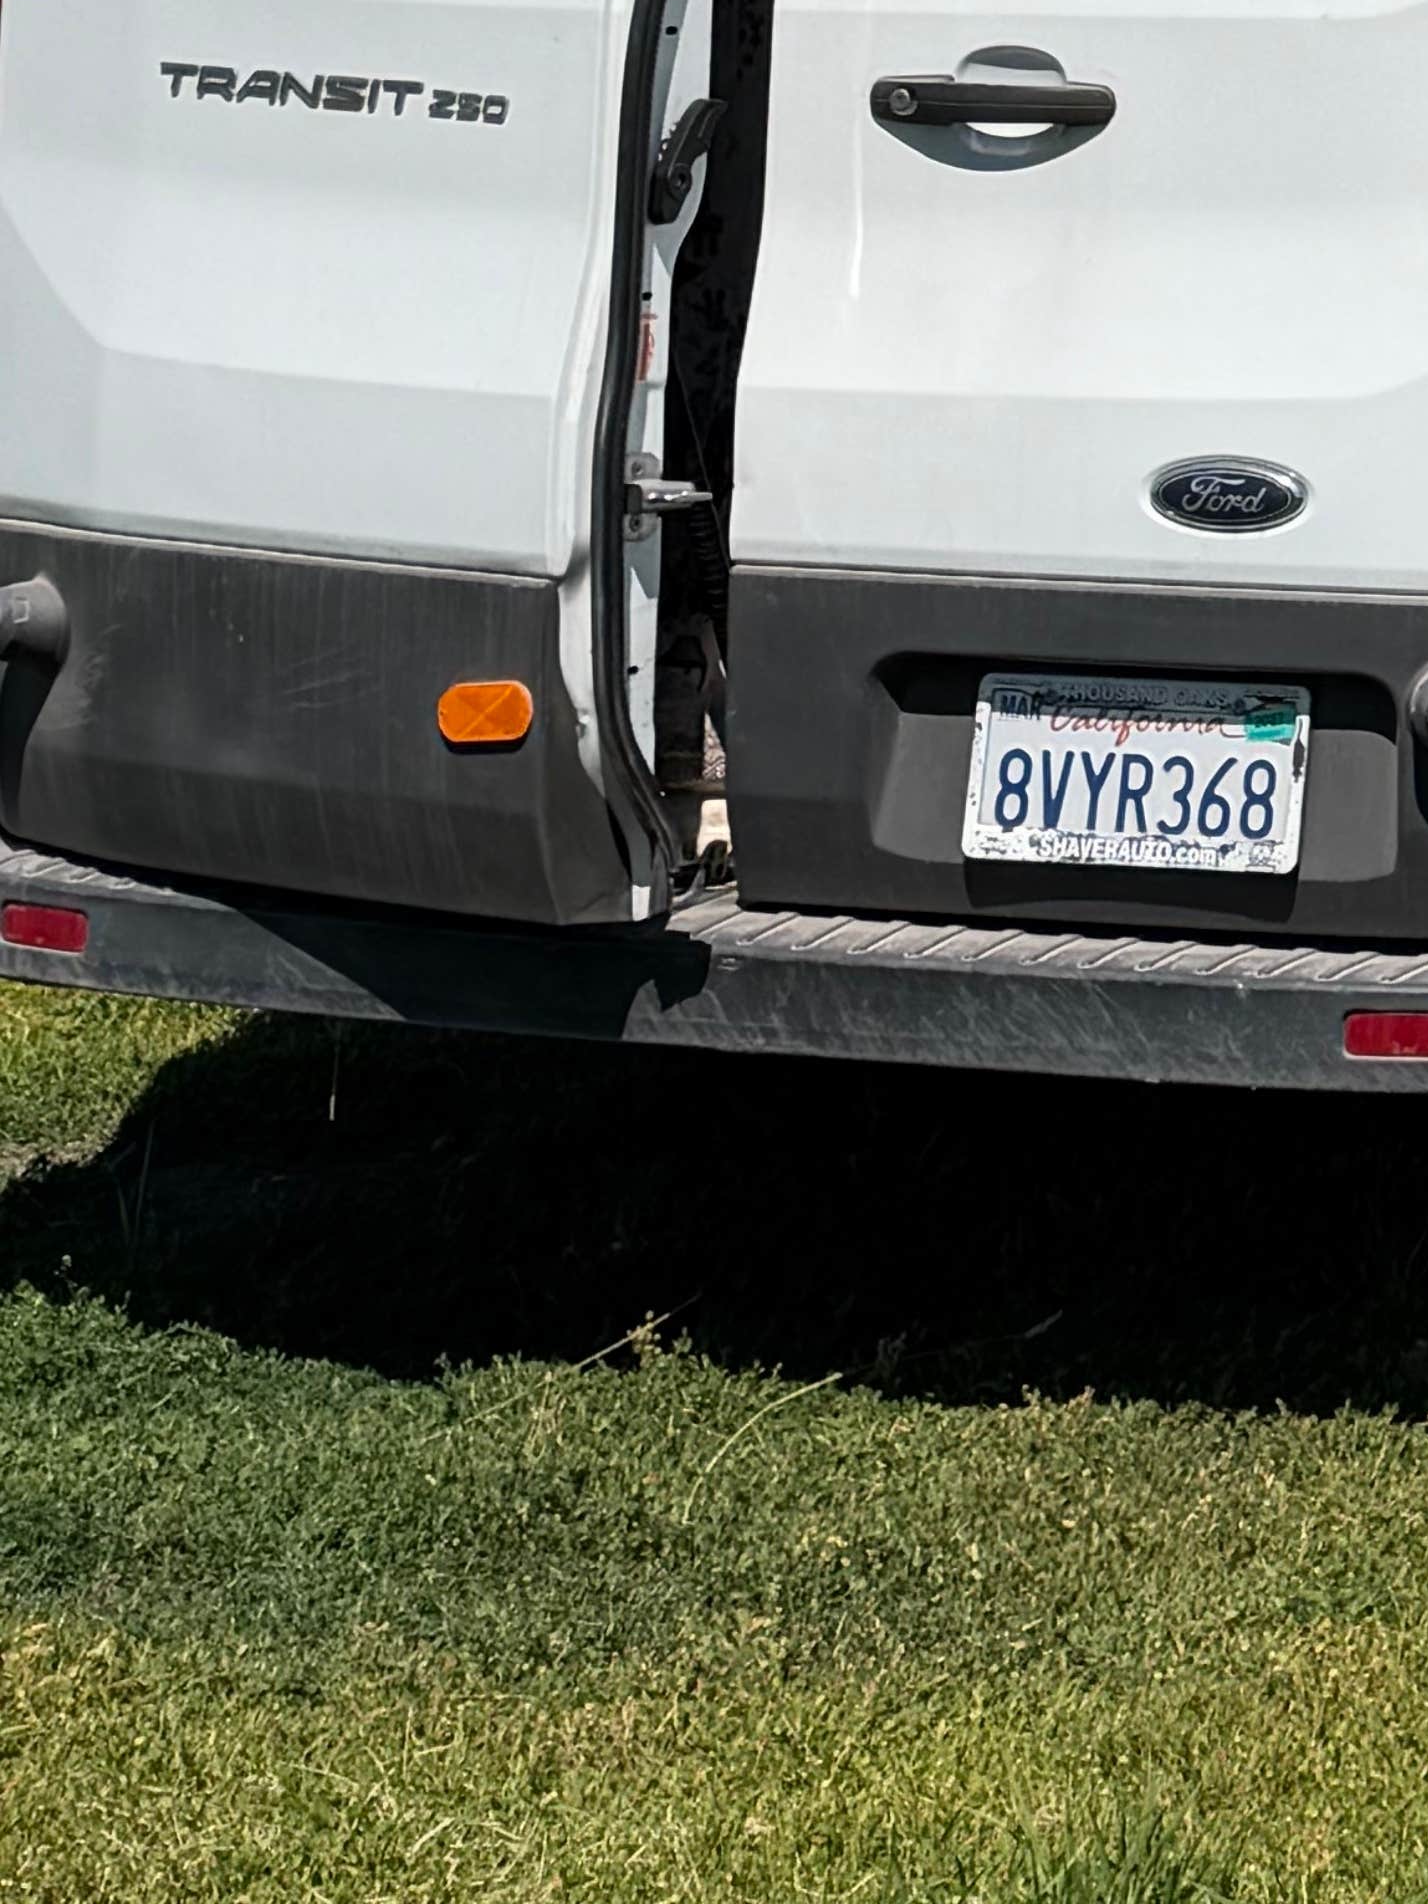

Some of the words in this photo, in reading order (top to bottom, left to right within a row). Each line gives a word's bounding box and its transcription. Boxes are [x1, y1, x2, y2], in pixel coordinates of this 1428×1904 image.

[159, 61, 425, 117] TRANSIT
[428, 89, 511, 126] 250
[1181, 475, 1267, 514] Ford
[1049, 703, 1235, 747] California
[993, 747, 1278, 840] 8VYR368
